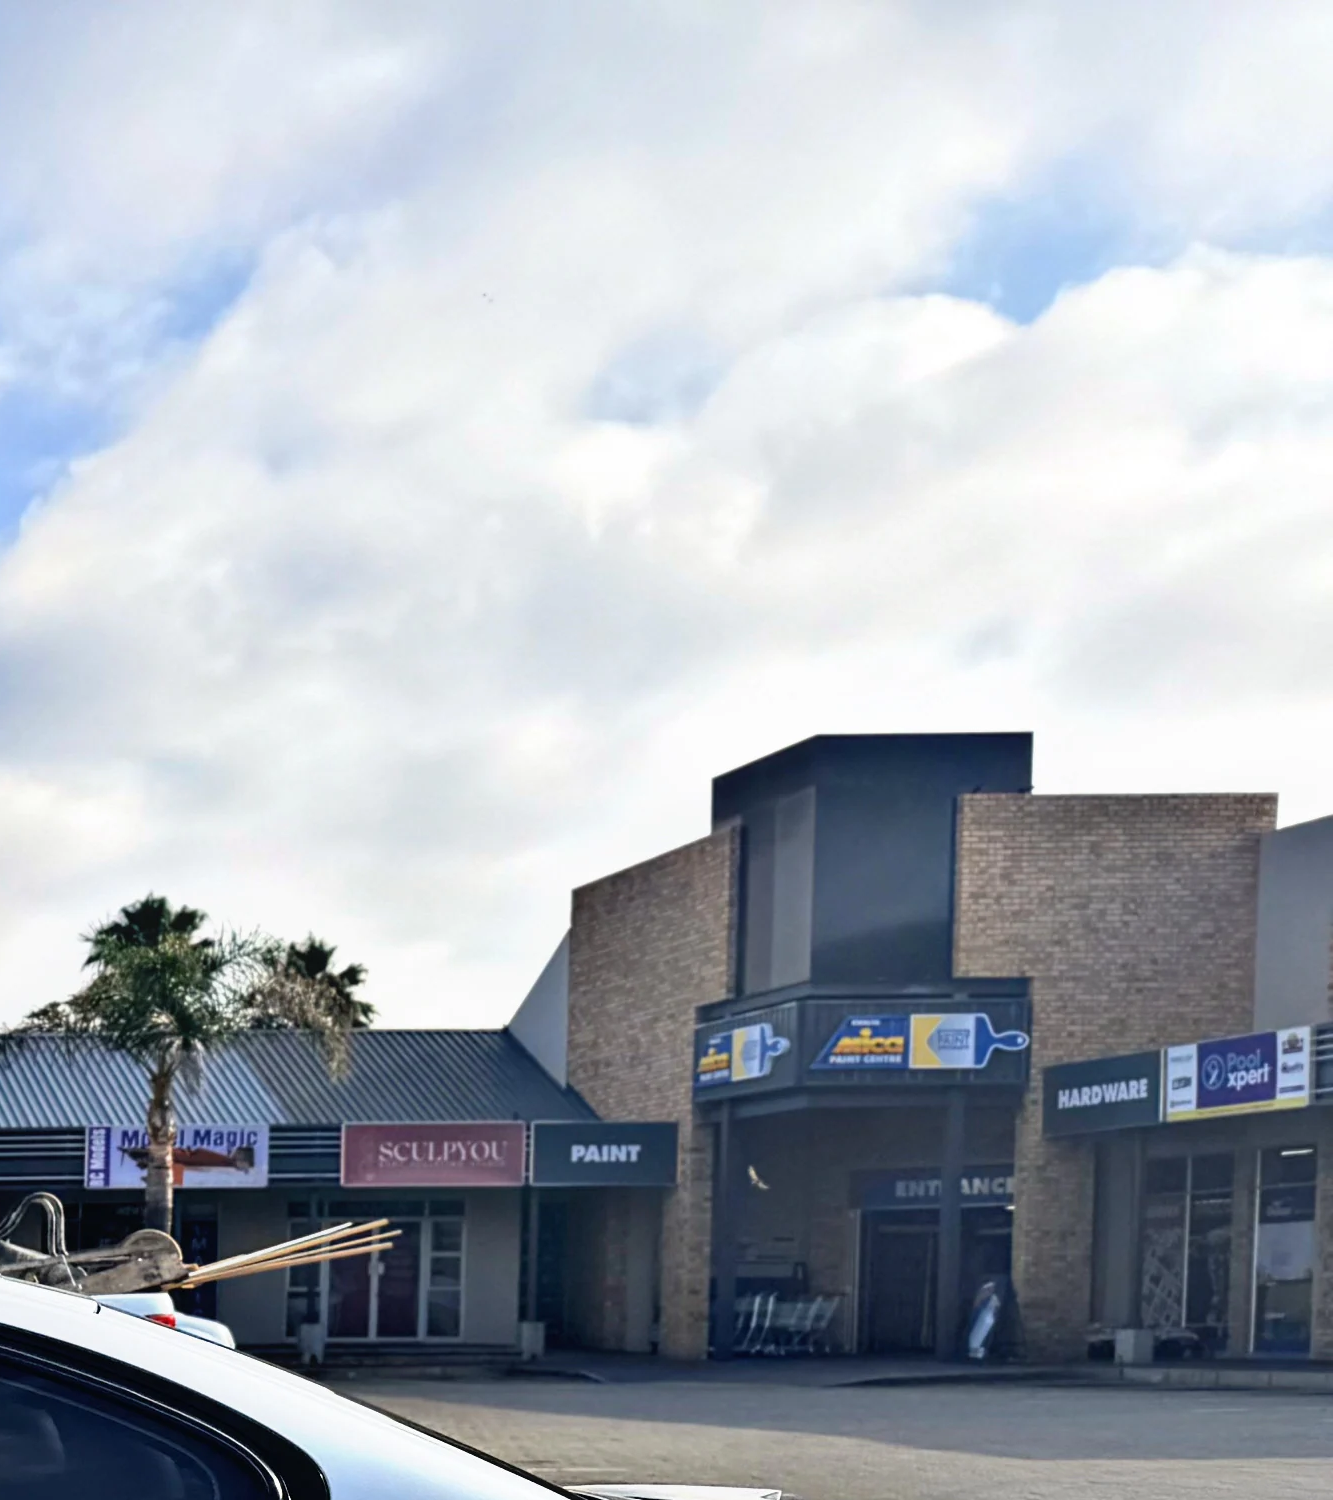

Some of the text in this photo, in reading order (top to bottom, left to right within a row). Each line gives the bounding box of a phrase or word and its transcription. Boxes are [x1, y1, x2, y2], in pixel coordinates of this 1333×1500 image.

[1227, 1049, 1261, 1069] Pool
[1227, 1063, 1271, 1091] xpert
[1057, 1078, 1149, 1110] HARDWARE
[89, 1129, 106, 1170] Models
[193, 1128, 258, 1154] Magic
[378, 1140, 508, 1162] SCULPYOU
[570, 1144, 642, 1163] PAINT
